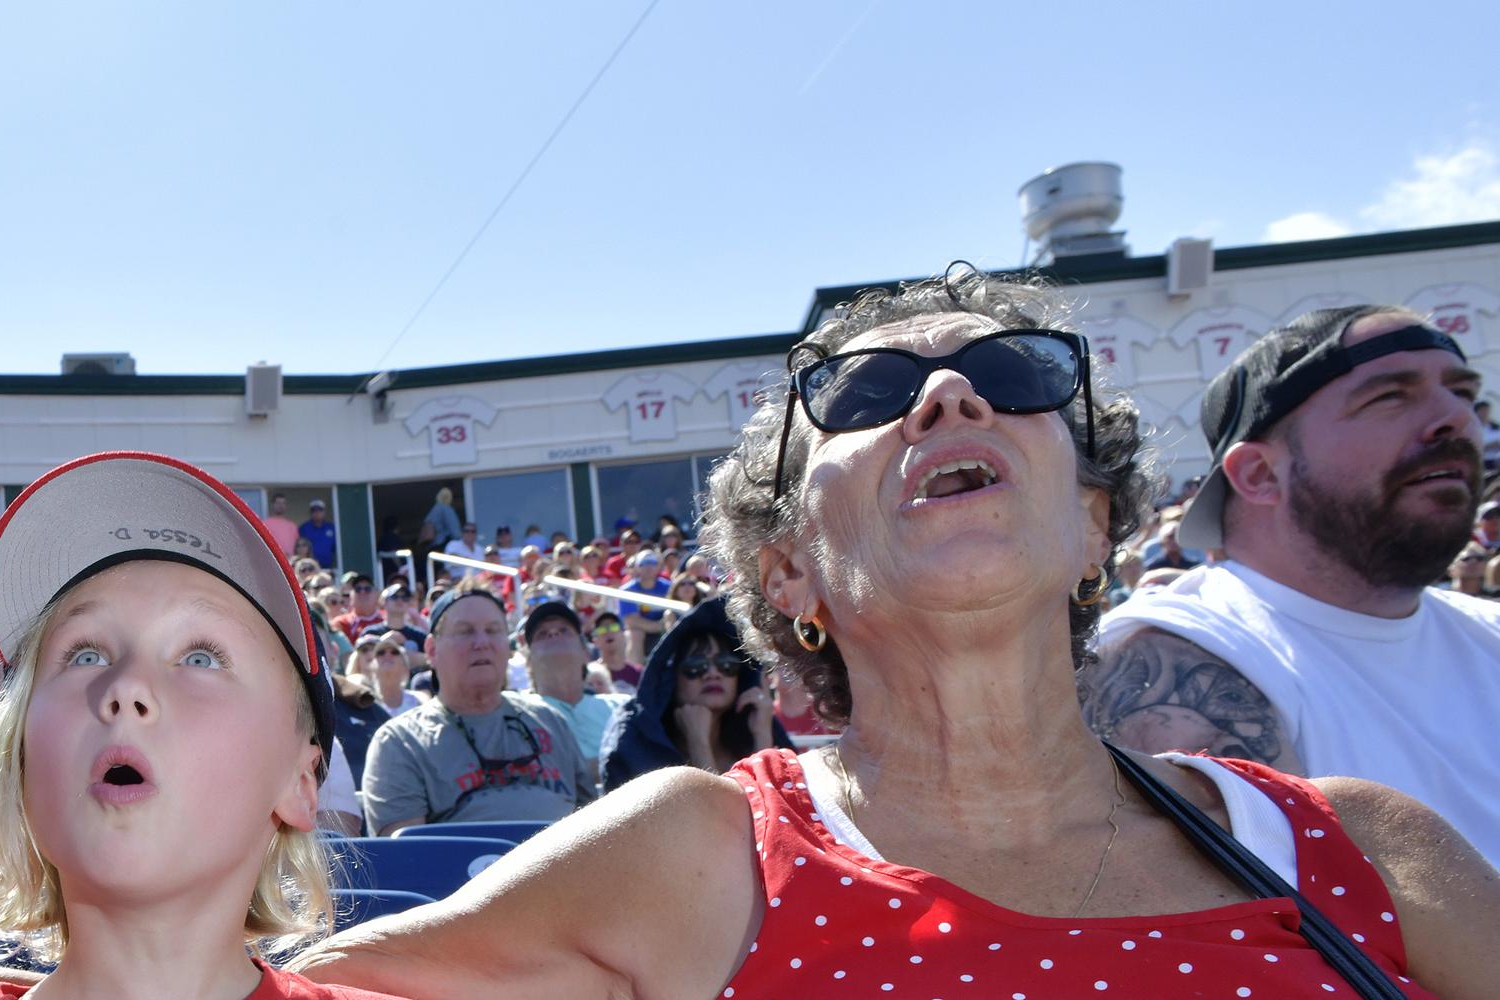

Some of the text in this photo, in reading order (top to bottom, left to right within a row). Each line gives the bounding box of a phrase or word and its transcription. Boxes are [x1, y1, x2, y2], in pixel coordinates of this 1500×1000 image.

[1214, 336, 1231, 356] 7
[636, 400, 665, 420] 17
[436, 424, 467, 444] 33
[143, 528, 222, 559] Tessa
